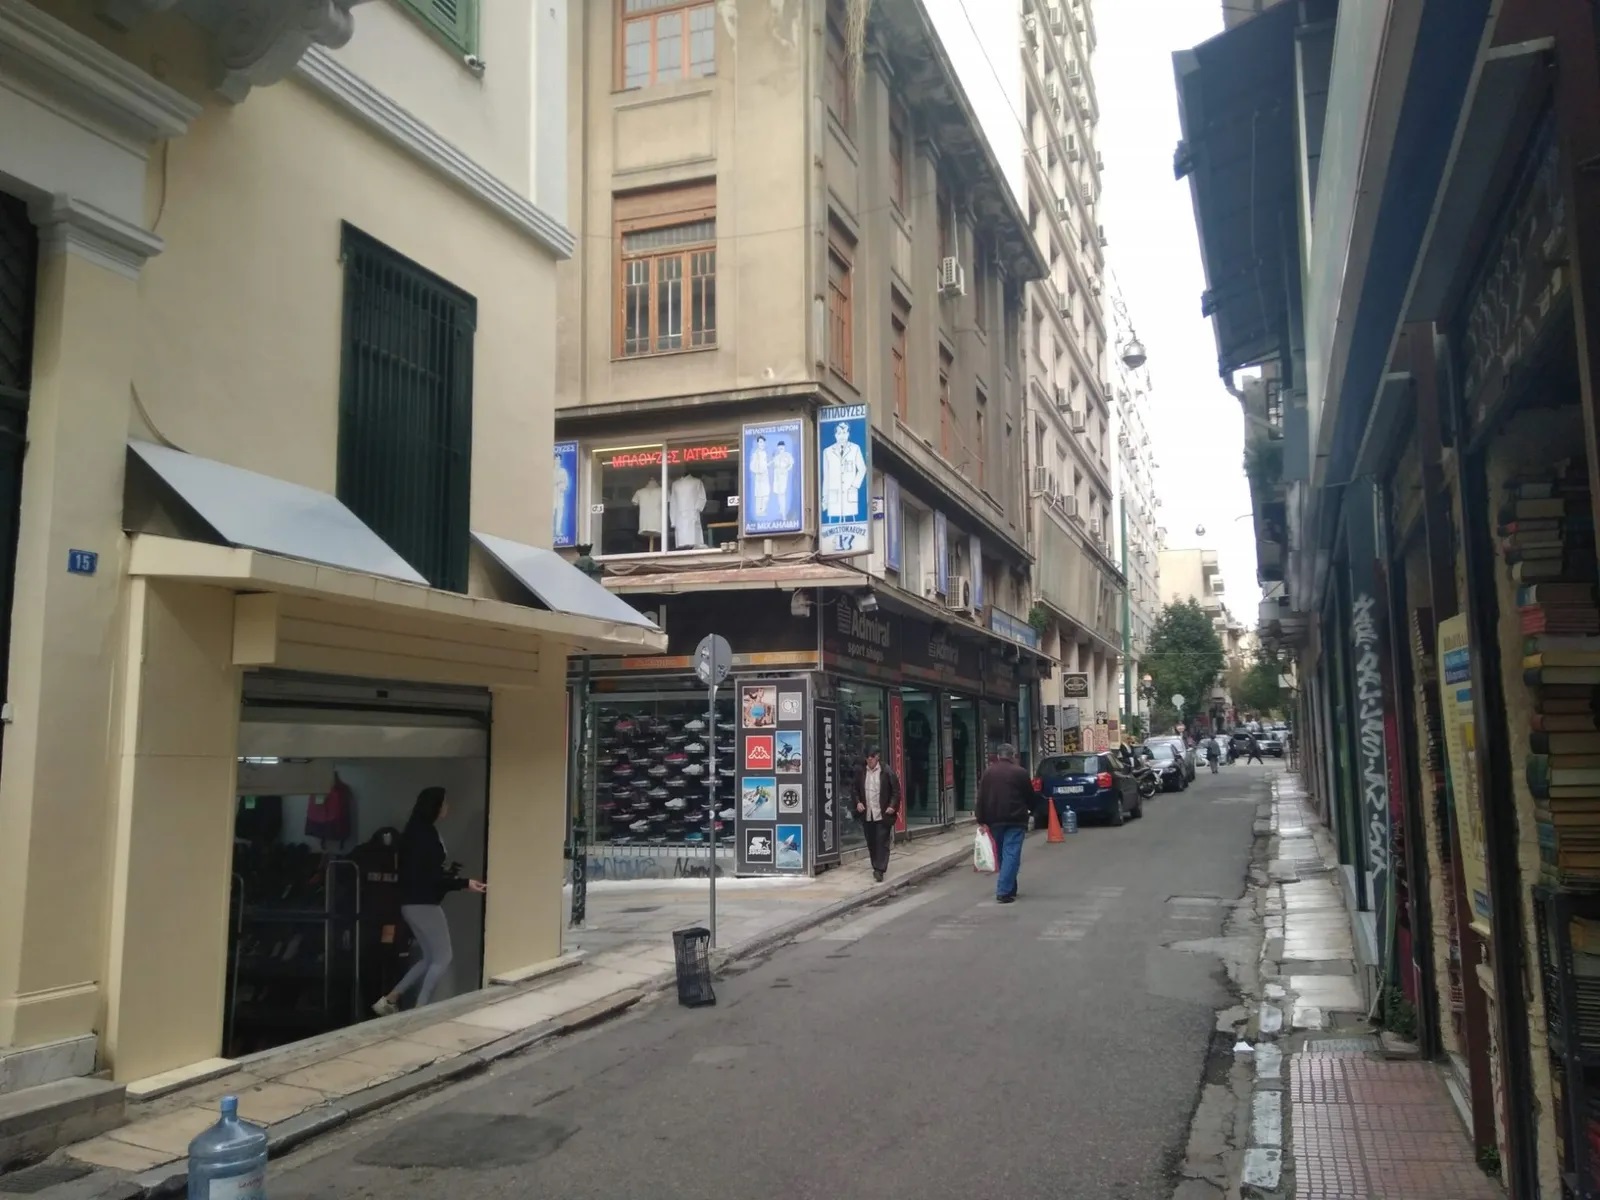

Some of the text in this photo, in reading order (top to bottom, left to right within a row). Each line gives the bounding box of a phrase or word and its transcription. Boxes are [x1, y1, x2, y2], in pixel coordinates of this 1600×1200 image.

[820, 404, 865, 420] ΜΠΛΟΥΖΕΣ
[554, 444, 576, 453] ΟΥΖΕΣ
[76, 554, 90, 571] 15
[851, 609, 890, 647] Admiral
[823, 716, 833, 818] Admiral
